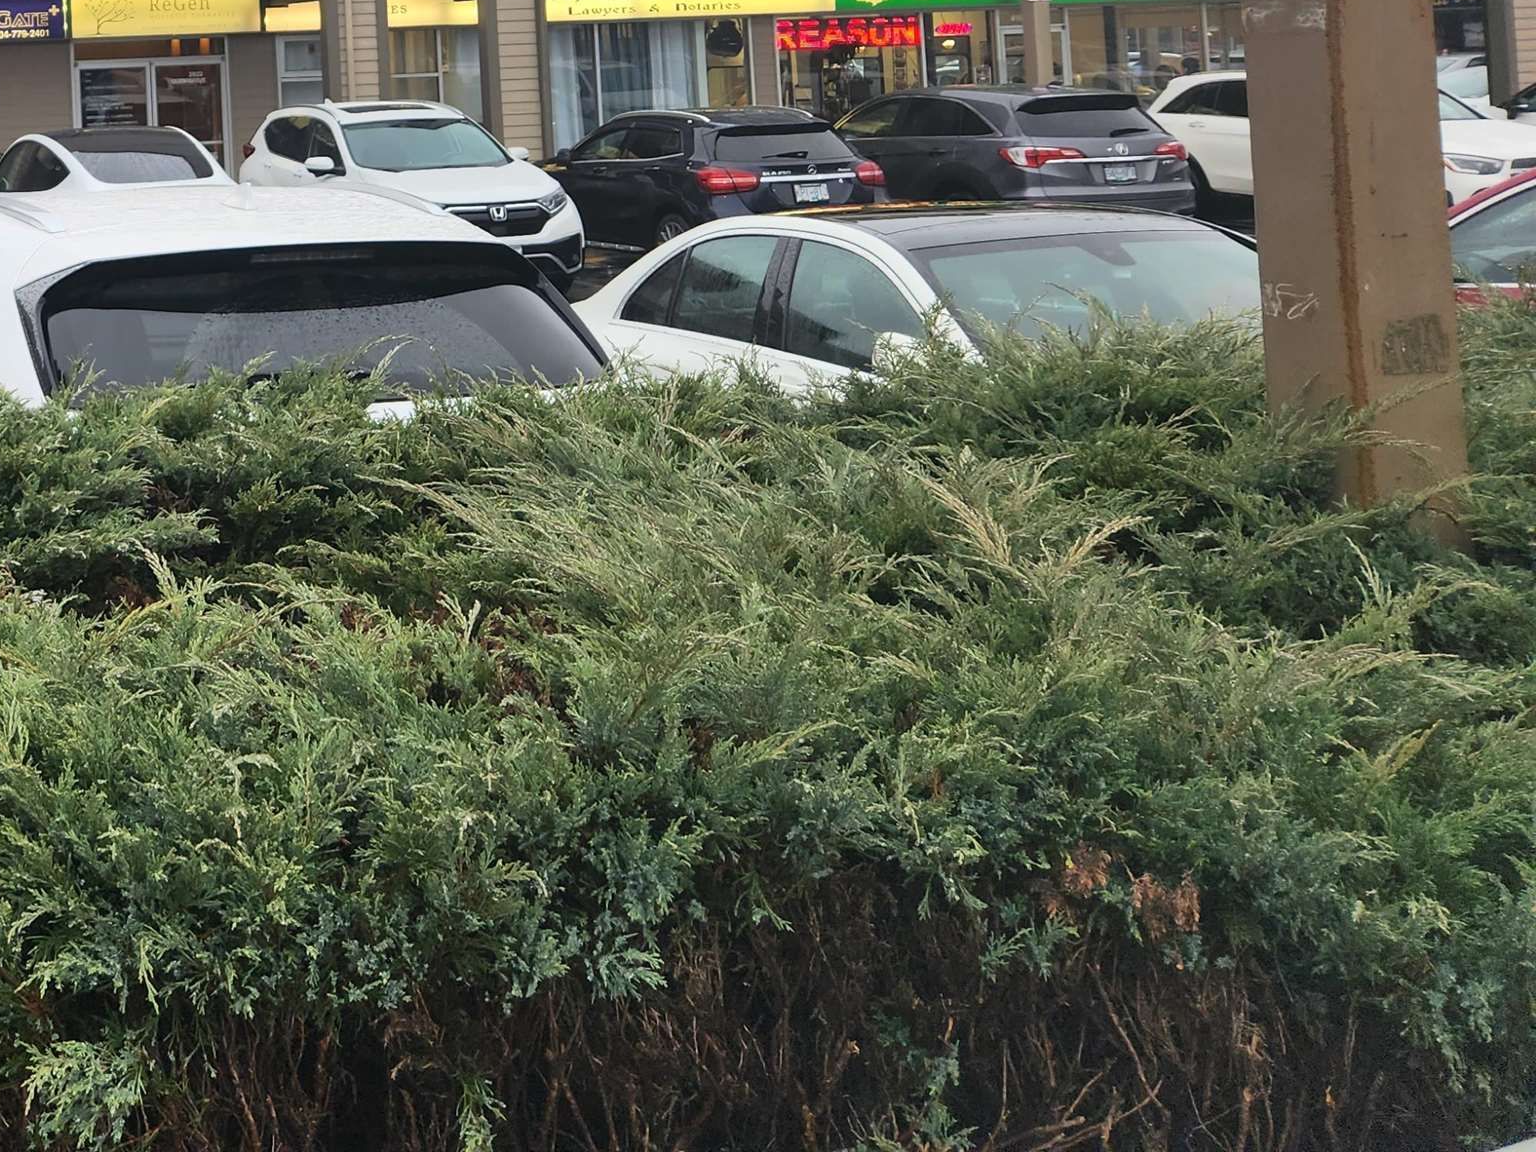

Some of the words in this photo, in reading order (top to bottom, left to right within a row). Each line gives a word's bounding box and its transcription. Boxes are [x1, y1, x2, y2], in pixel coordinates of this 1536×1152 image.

[391, 5, 407, 15] ES
[568, 4, 636, 16] Lawyers
[649, 4, 660, 13] &
[675, 1, 741, 12] Notaries
